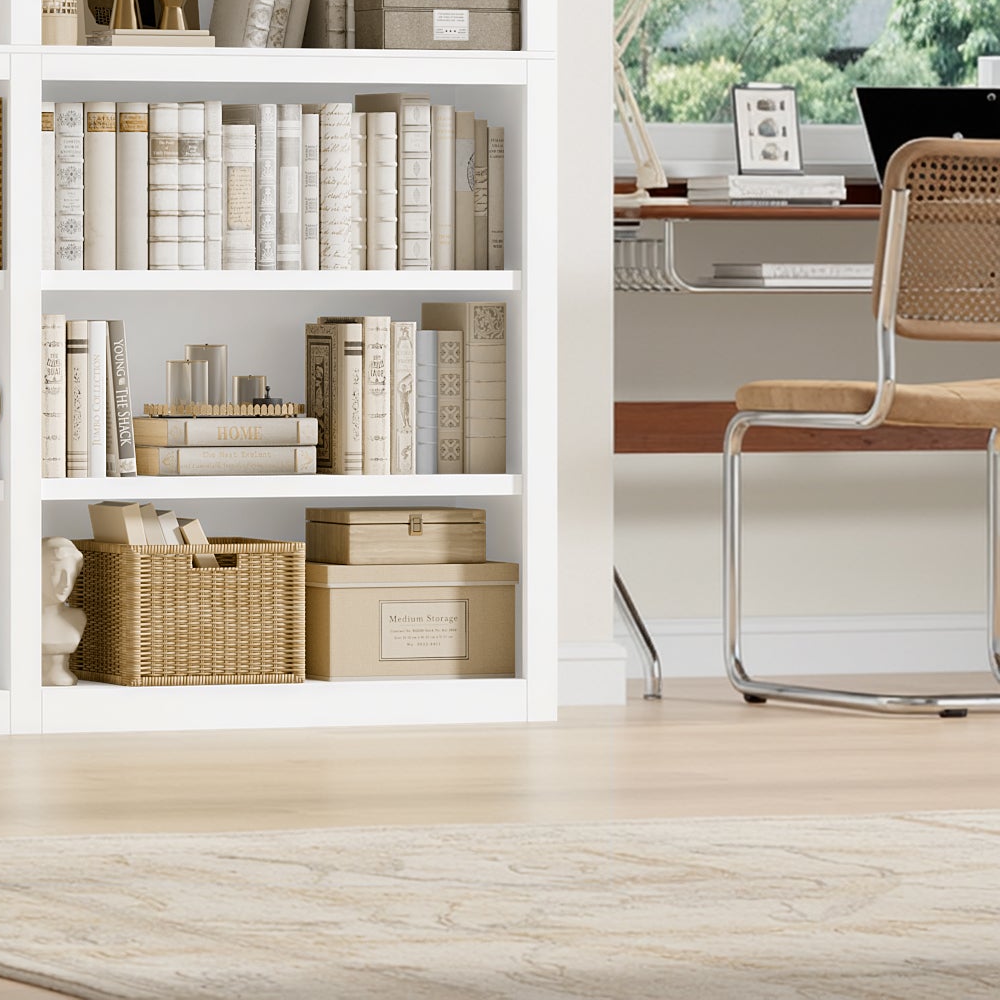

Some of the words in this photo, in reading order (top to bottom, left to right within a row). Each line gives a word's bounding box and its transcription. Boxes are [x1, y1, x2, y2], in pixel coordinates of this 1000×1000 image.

[113, 339, 126, 377] YOUNG
[115, 387, 129, 408] THE
[117, 411, 132, 447] SHACK
[216, 426, 263, 440] HOME
[389, 615, 424, 623] Medium
[426, 615, 459, 624] Storage
